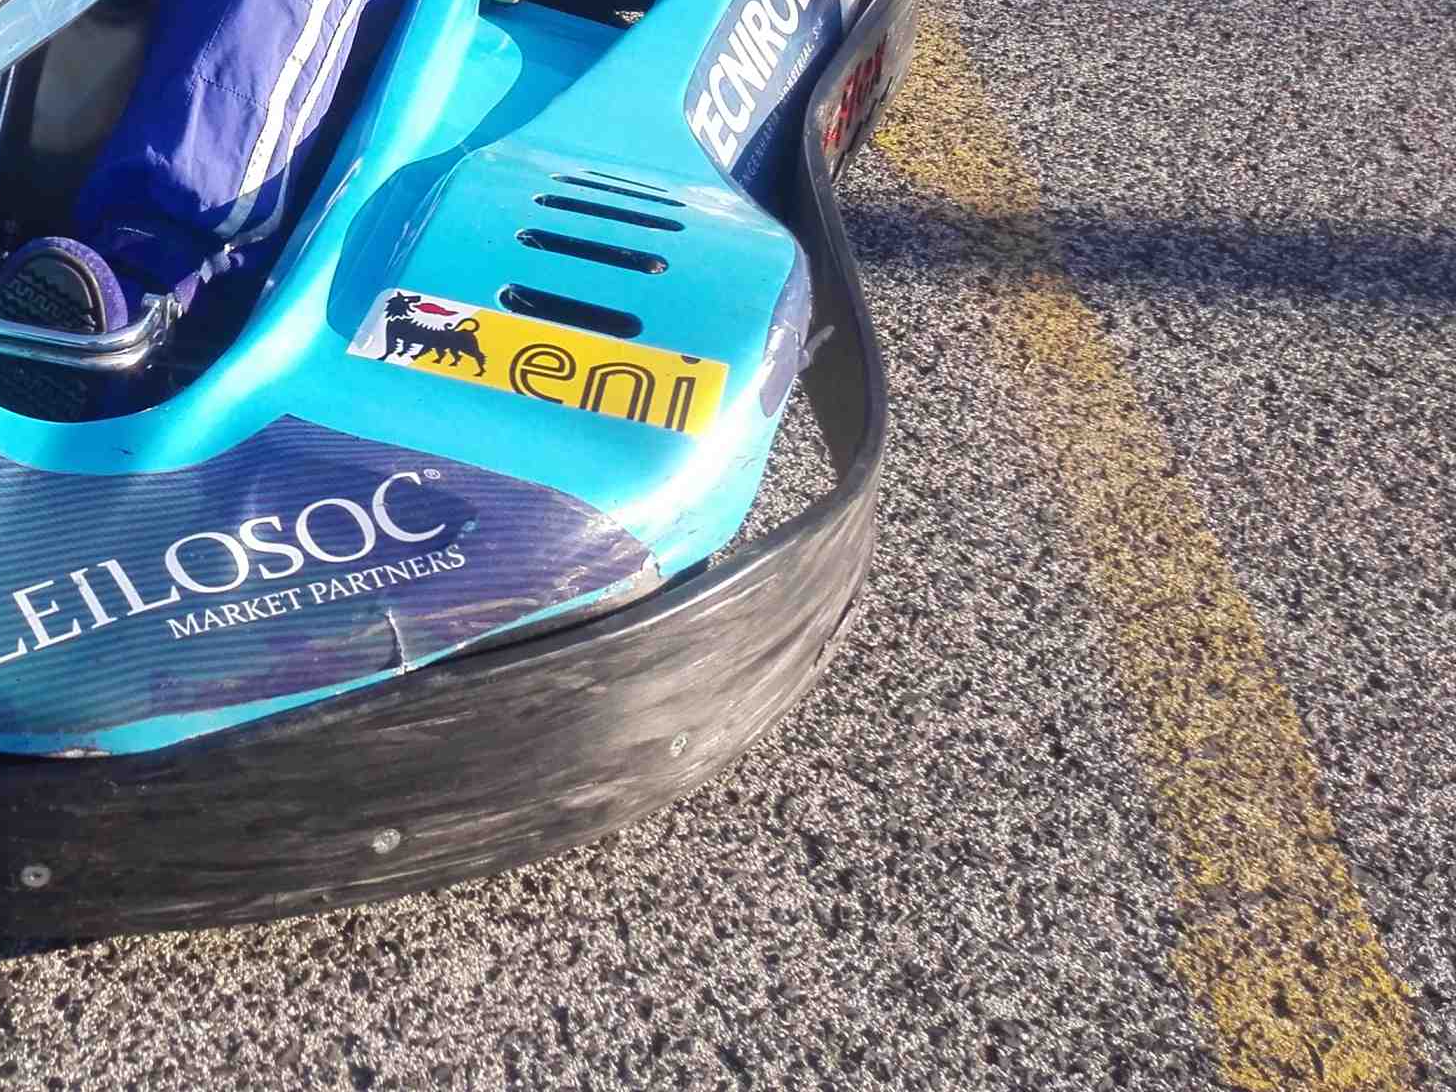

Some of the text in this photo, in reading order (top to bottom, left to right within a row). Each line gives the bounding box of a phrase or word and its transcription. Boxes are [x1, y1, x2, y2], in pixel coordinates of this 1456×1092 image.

[509, 343, 702, 432] eni
[166, 544, 467, 640] MARKET PARTNERS
